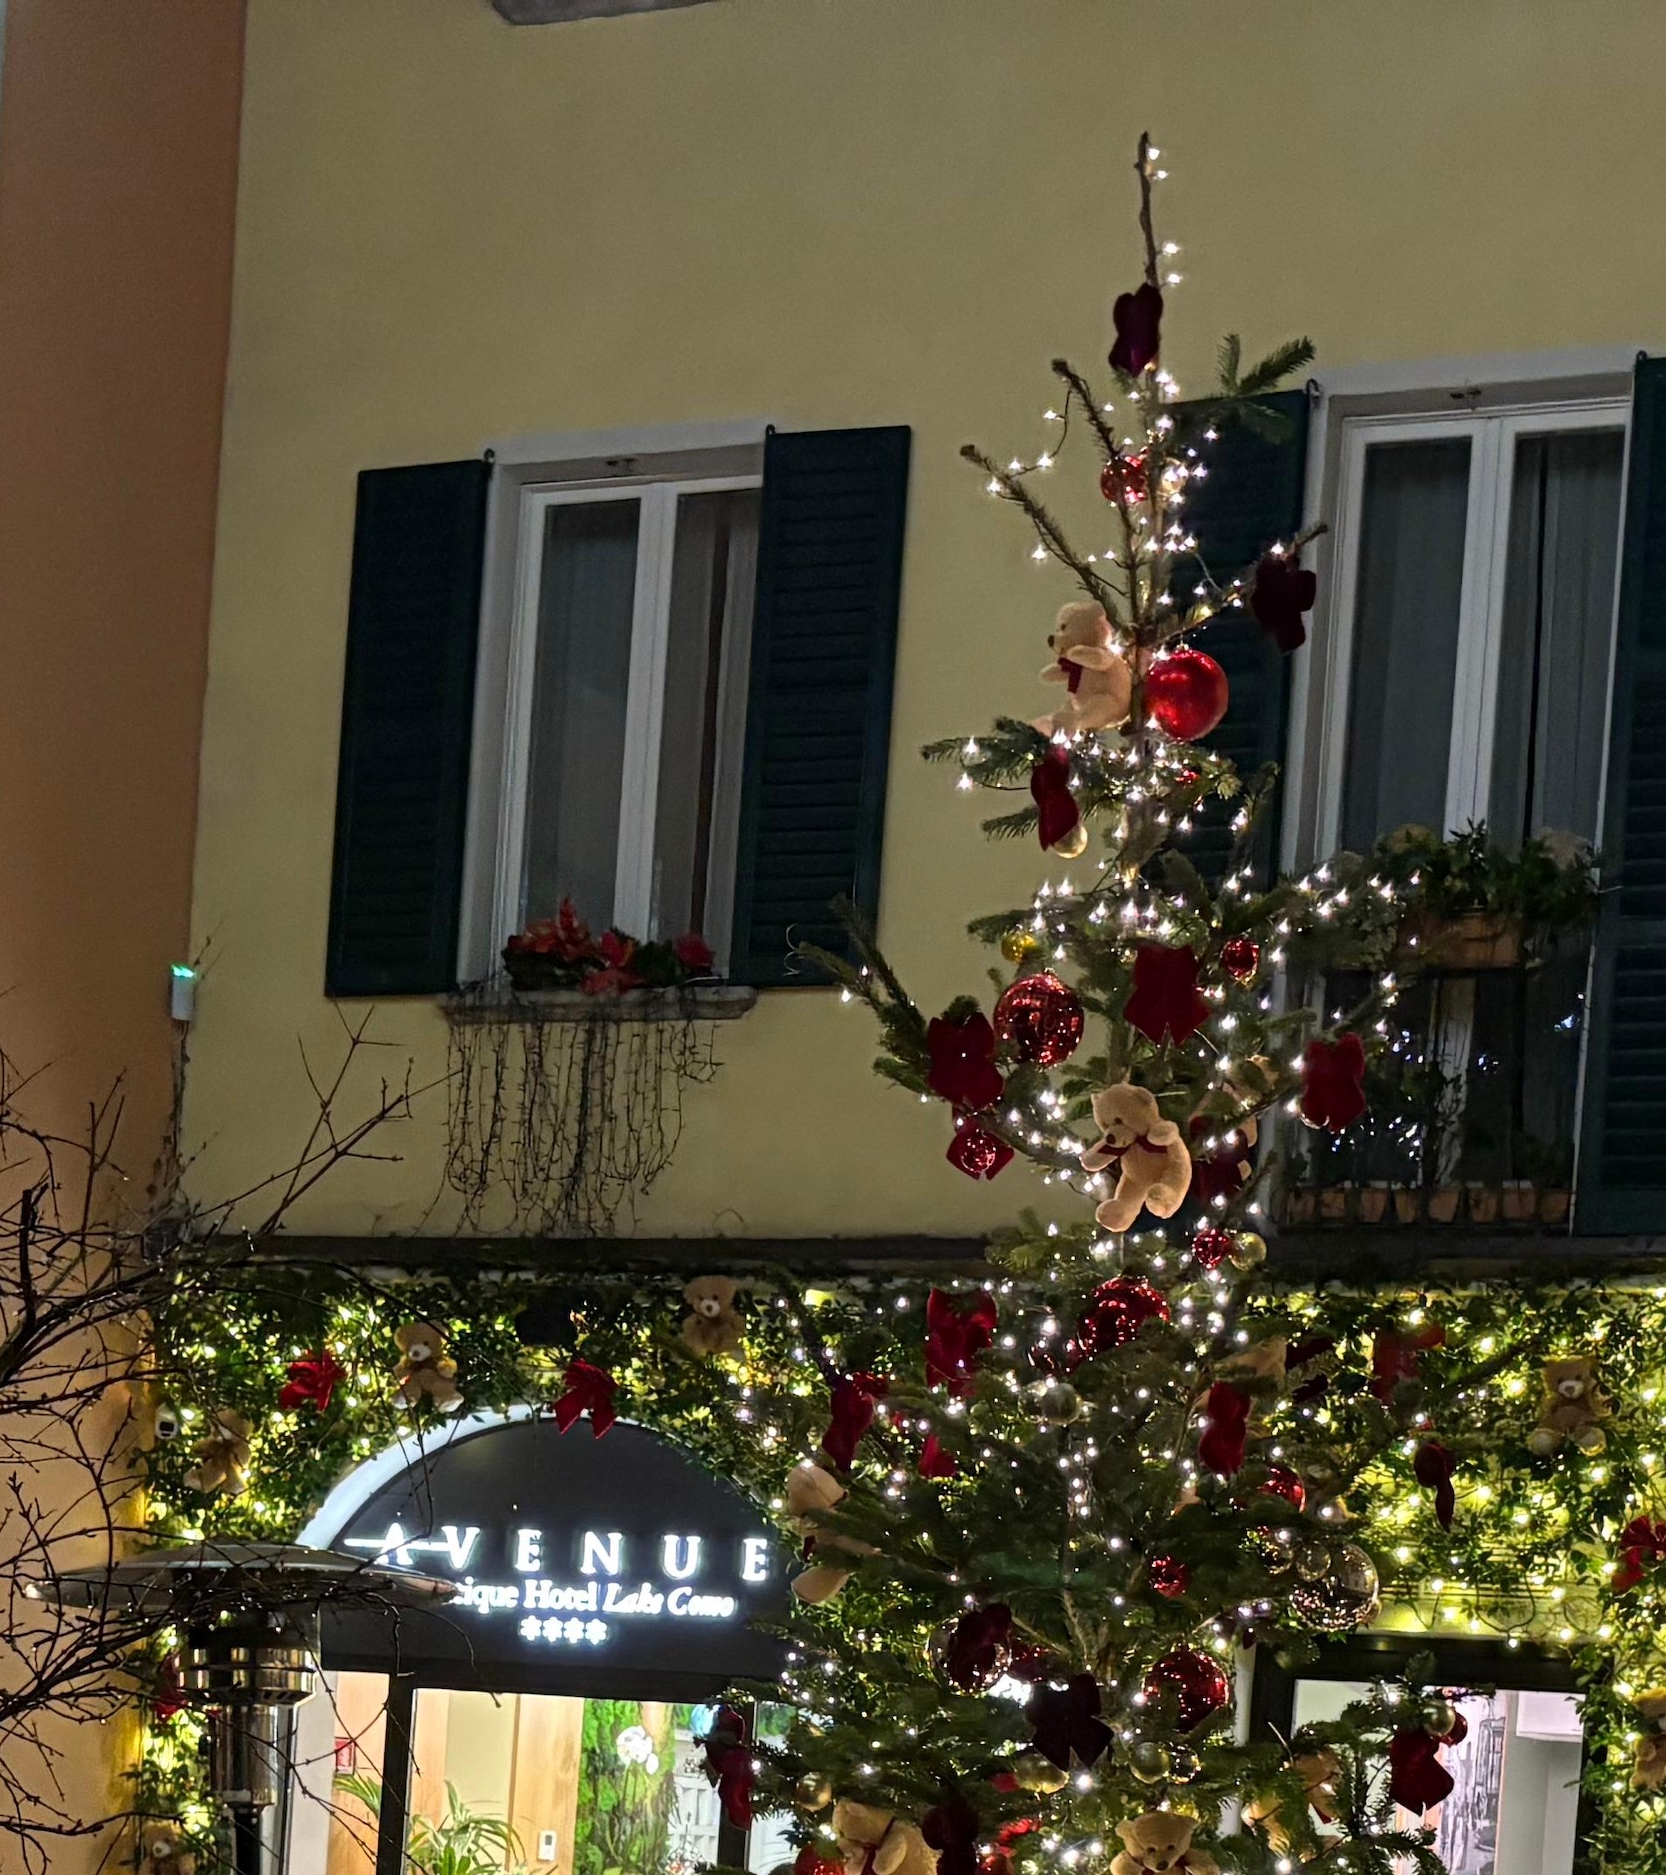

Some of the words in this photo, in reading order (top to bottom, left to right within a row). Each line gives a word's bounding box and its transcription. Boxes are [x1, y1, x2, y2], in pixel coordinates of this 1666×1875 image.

[345, 1522, 769, 1582] AVENUE
[523, 1579, 598, 1612] Hotel
[603, 1582, 665, 1615] Lake
[667, 1586, 735, 1617] Como
